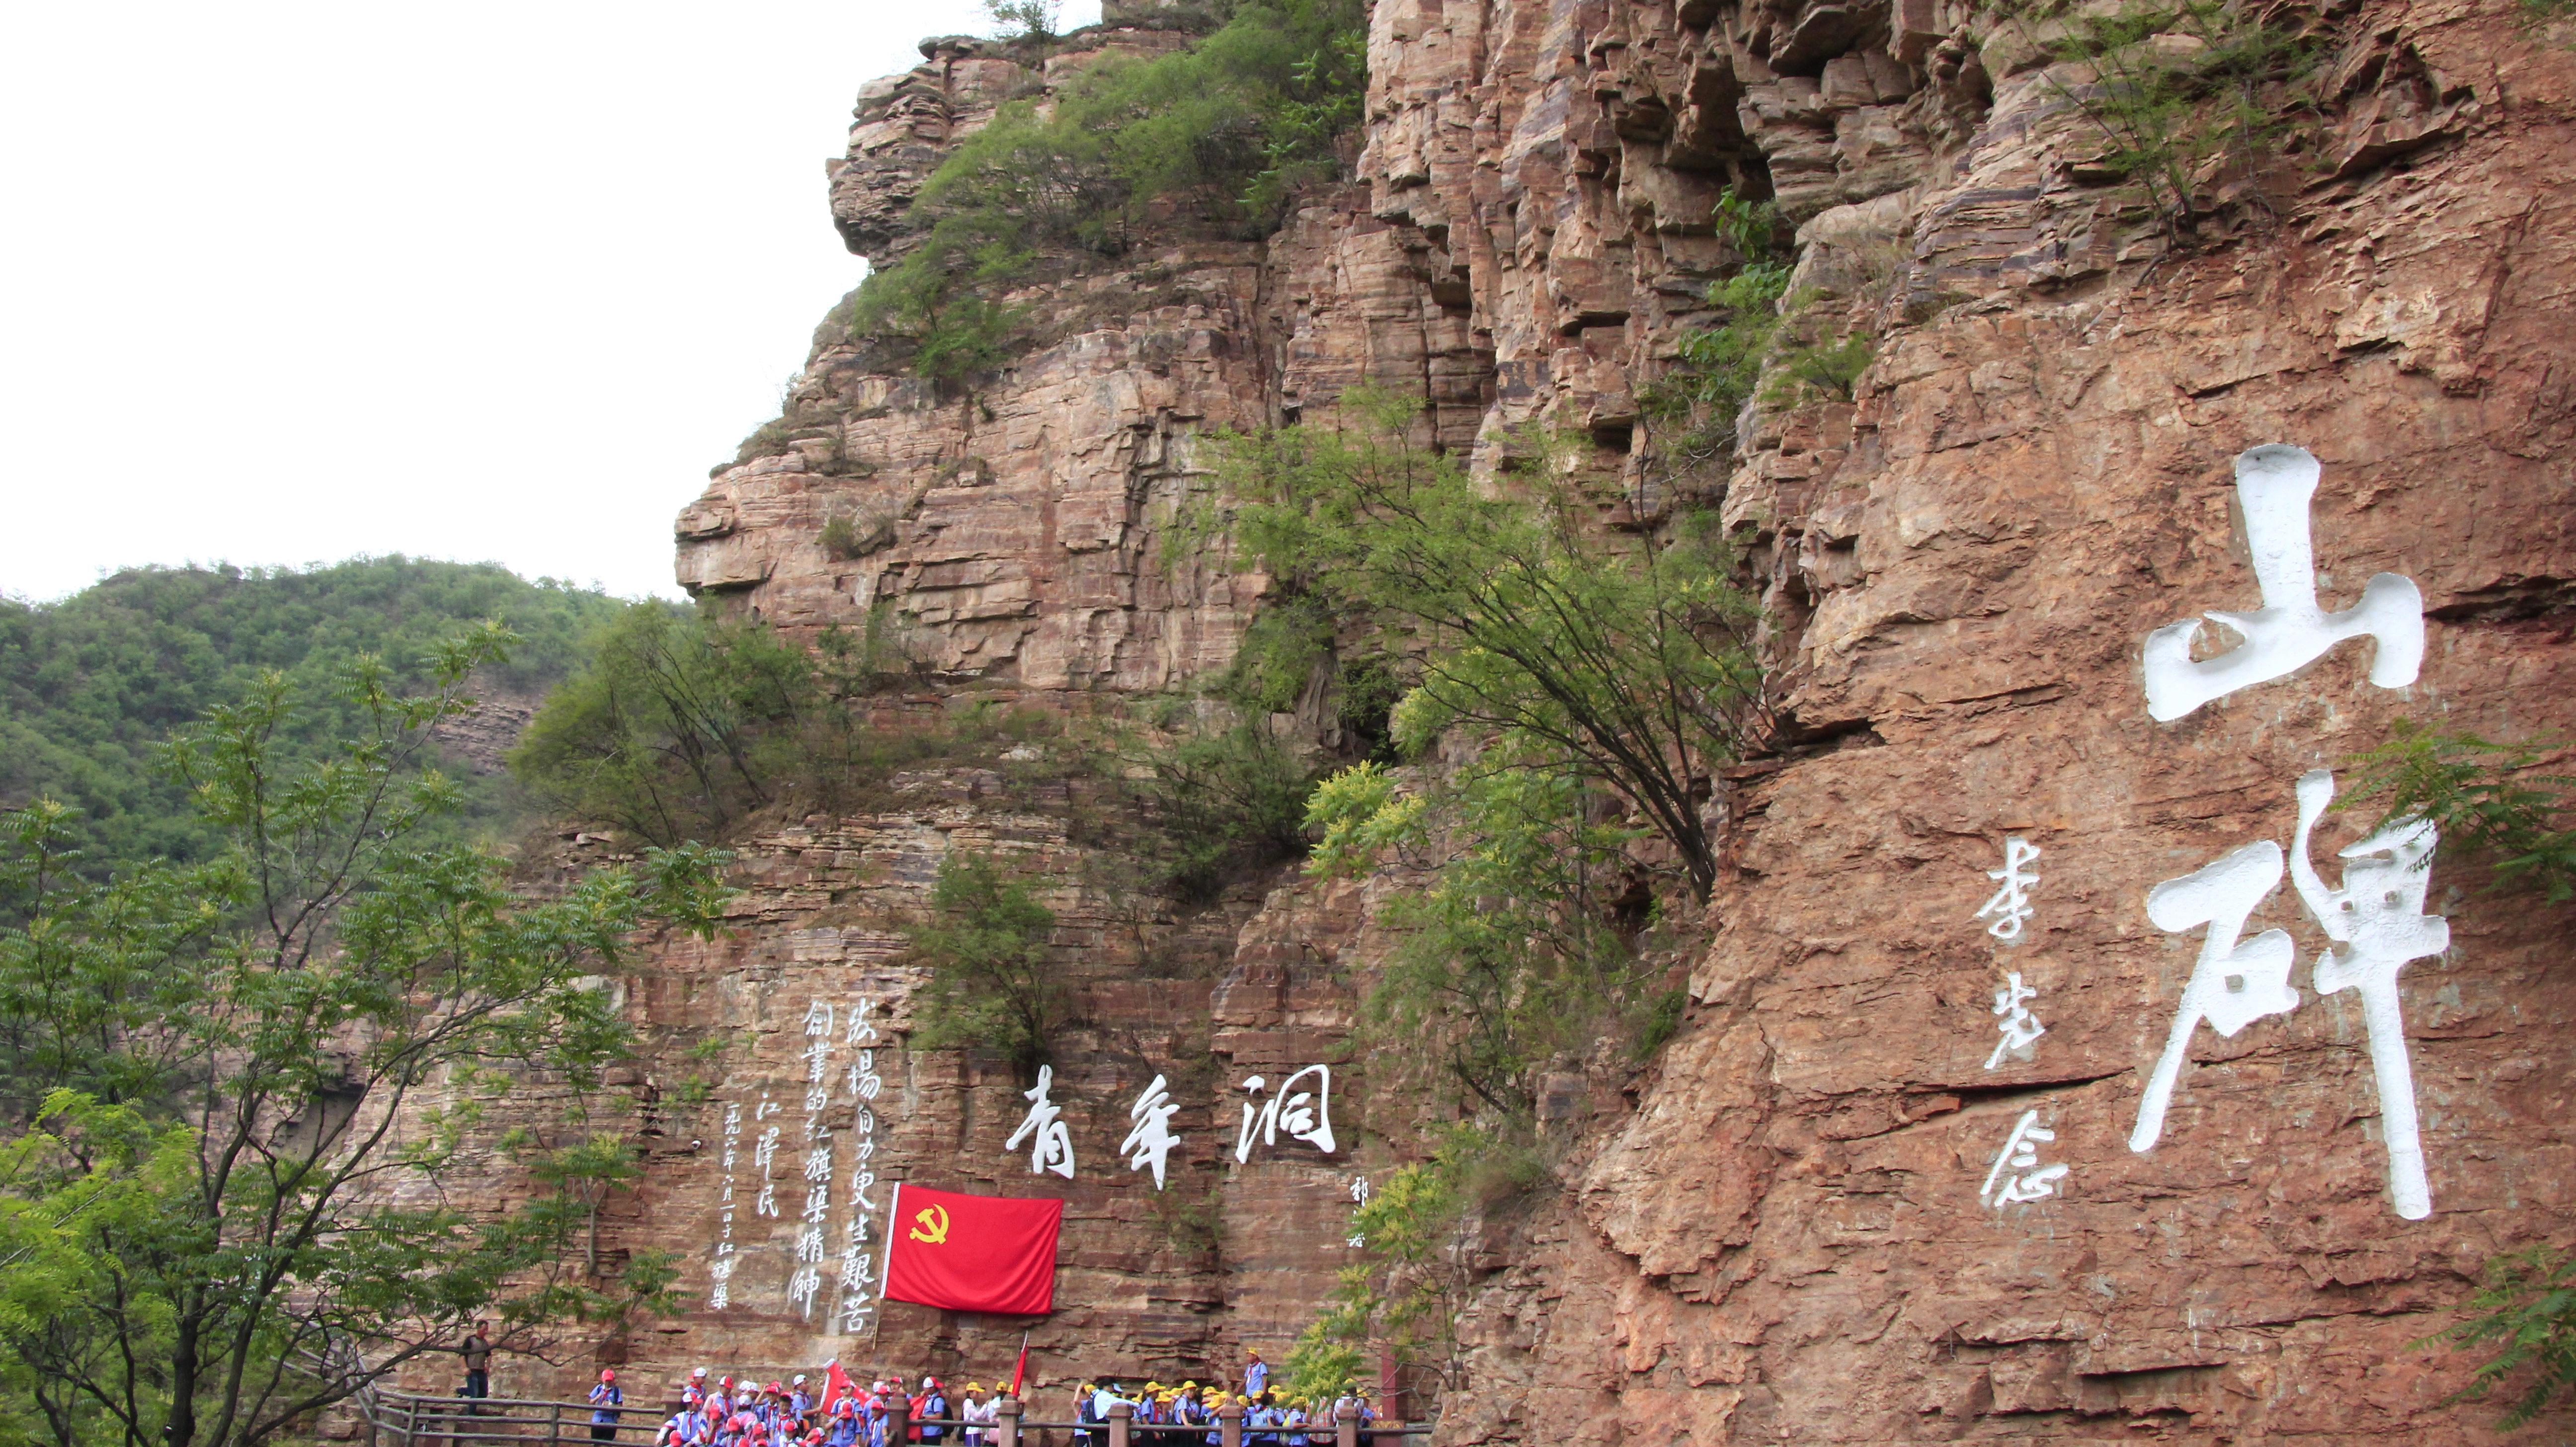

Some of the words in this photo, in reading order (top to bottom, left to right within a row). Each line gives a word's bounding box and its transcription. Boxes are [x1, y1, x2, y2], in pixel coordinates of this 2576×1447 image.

[2129, 442, 2451, 1220] 山碑
[1005, 1063, 1337, 1191] 青年洞
[1975, 836, 2069, 1209] 李先念
[1346, 1175, 1368, 1248] 郭若
